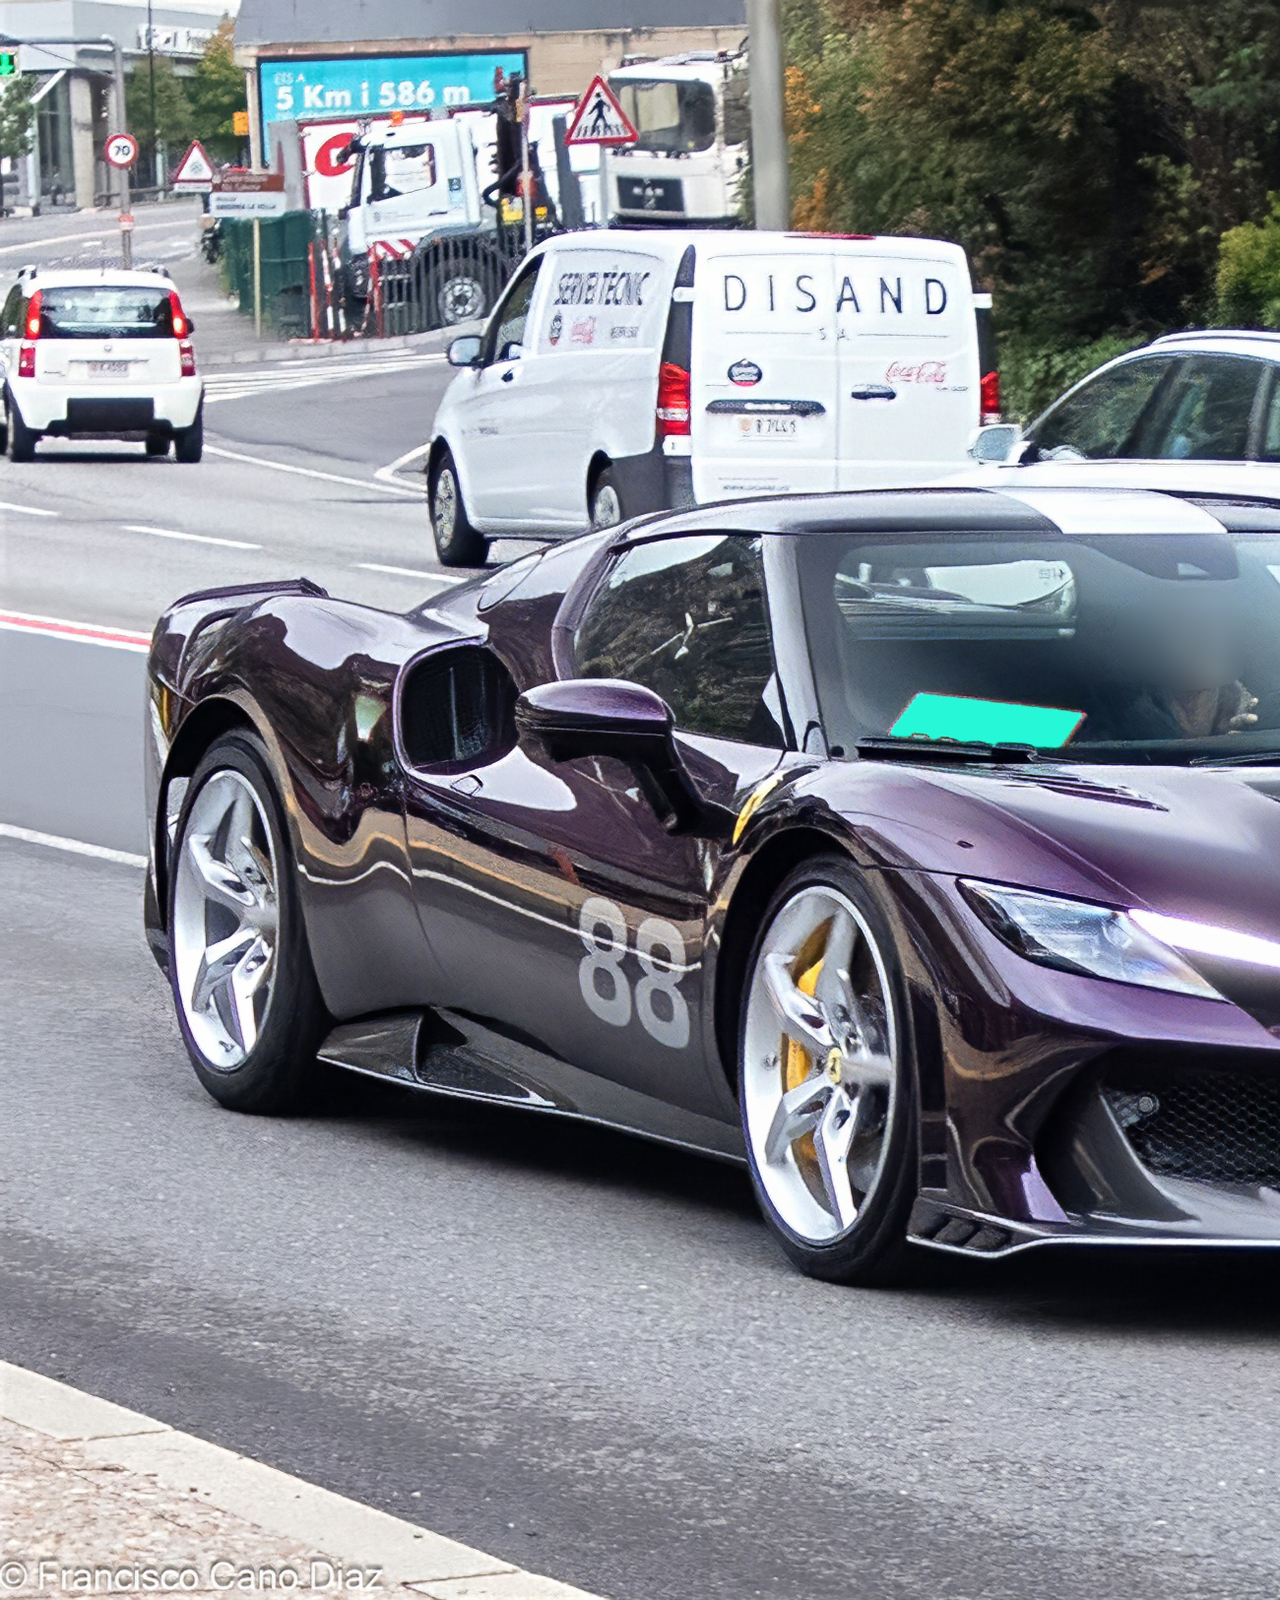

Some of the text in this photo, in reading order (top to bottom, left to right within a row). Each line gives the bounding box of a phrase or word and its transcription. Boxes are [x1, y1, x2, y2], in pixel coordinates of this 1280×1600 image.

[276, 81, 471, 110] 5 Km i 586 m
[114, 145, 130, 156] 70
[724, 275, 948, 315] DISAND
[579, 896, 690, 1049] 88
